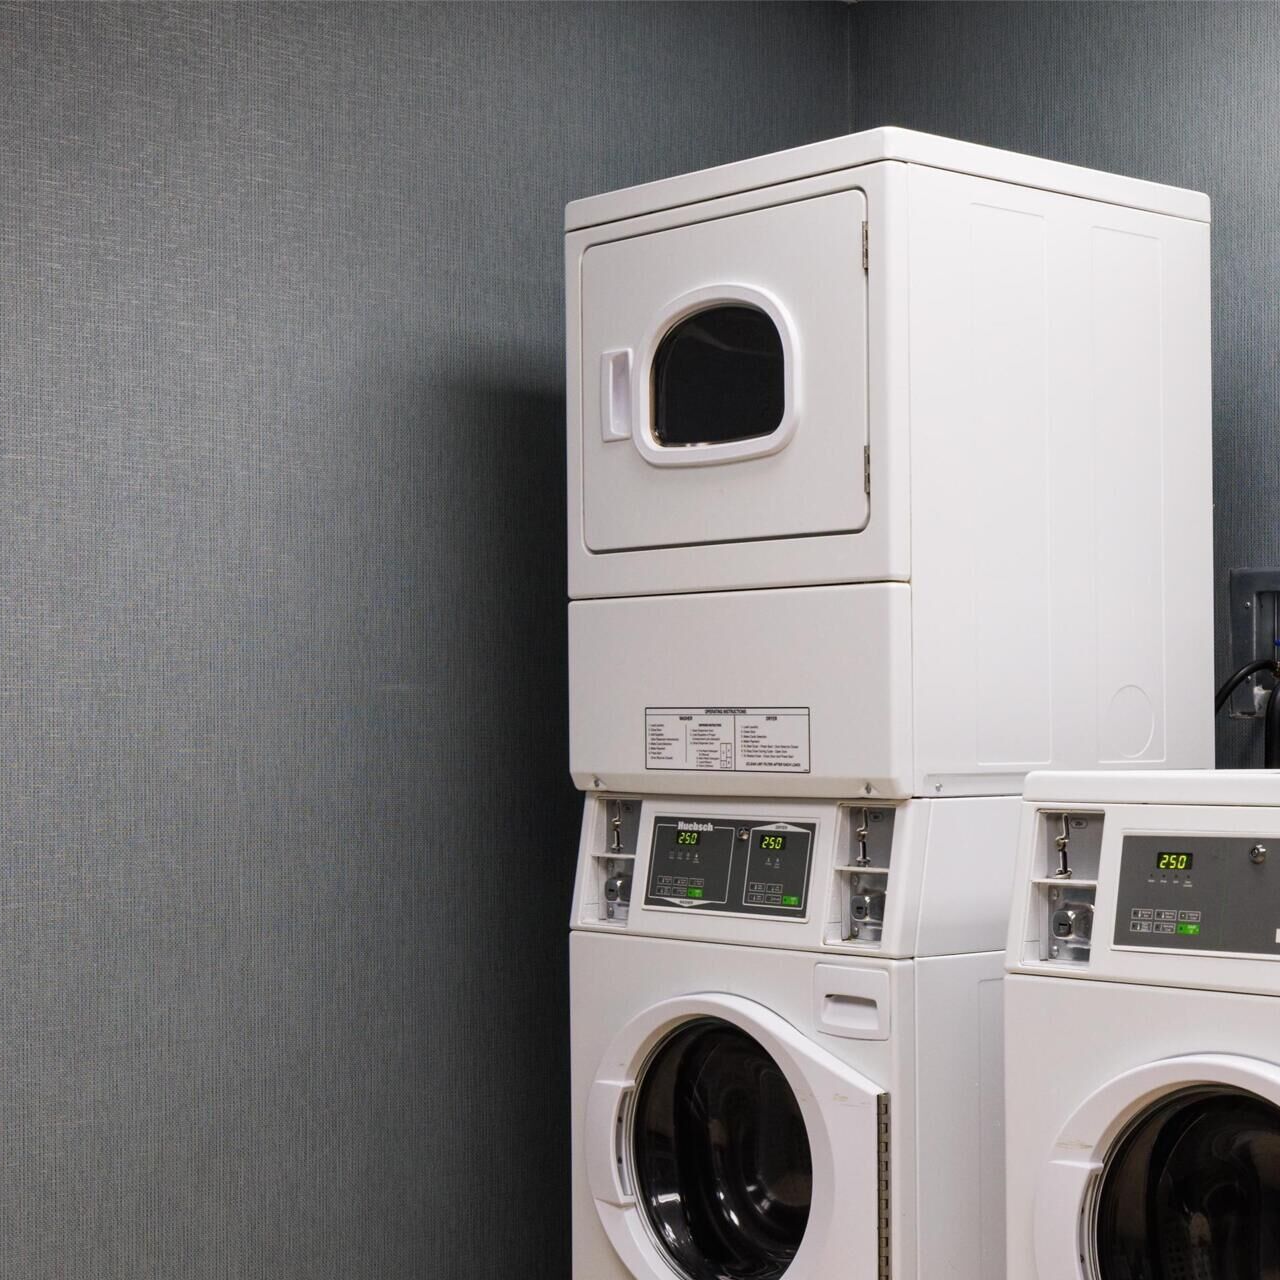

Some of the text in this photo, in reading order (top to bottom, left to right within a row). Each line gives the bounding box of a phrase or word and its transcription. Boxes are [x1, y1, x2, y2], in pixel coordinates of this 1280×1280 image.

[678, 821, 714, 832] Huebsch
[679, 833, 698, 844] 250
[762, 837, 782, 849] 250
[1160, 855, 1187, 869] 250
